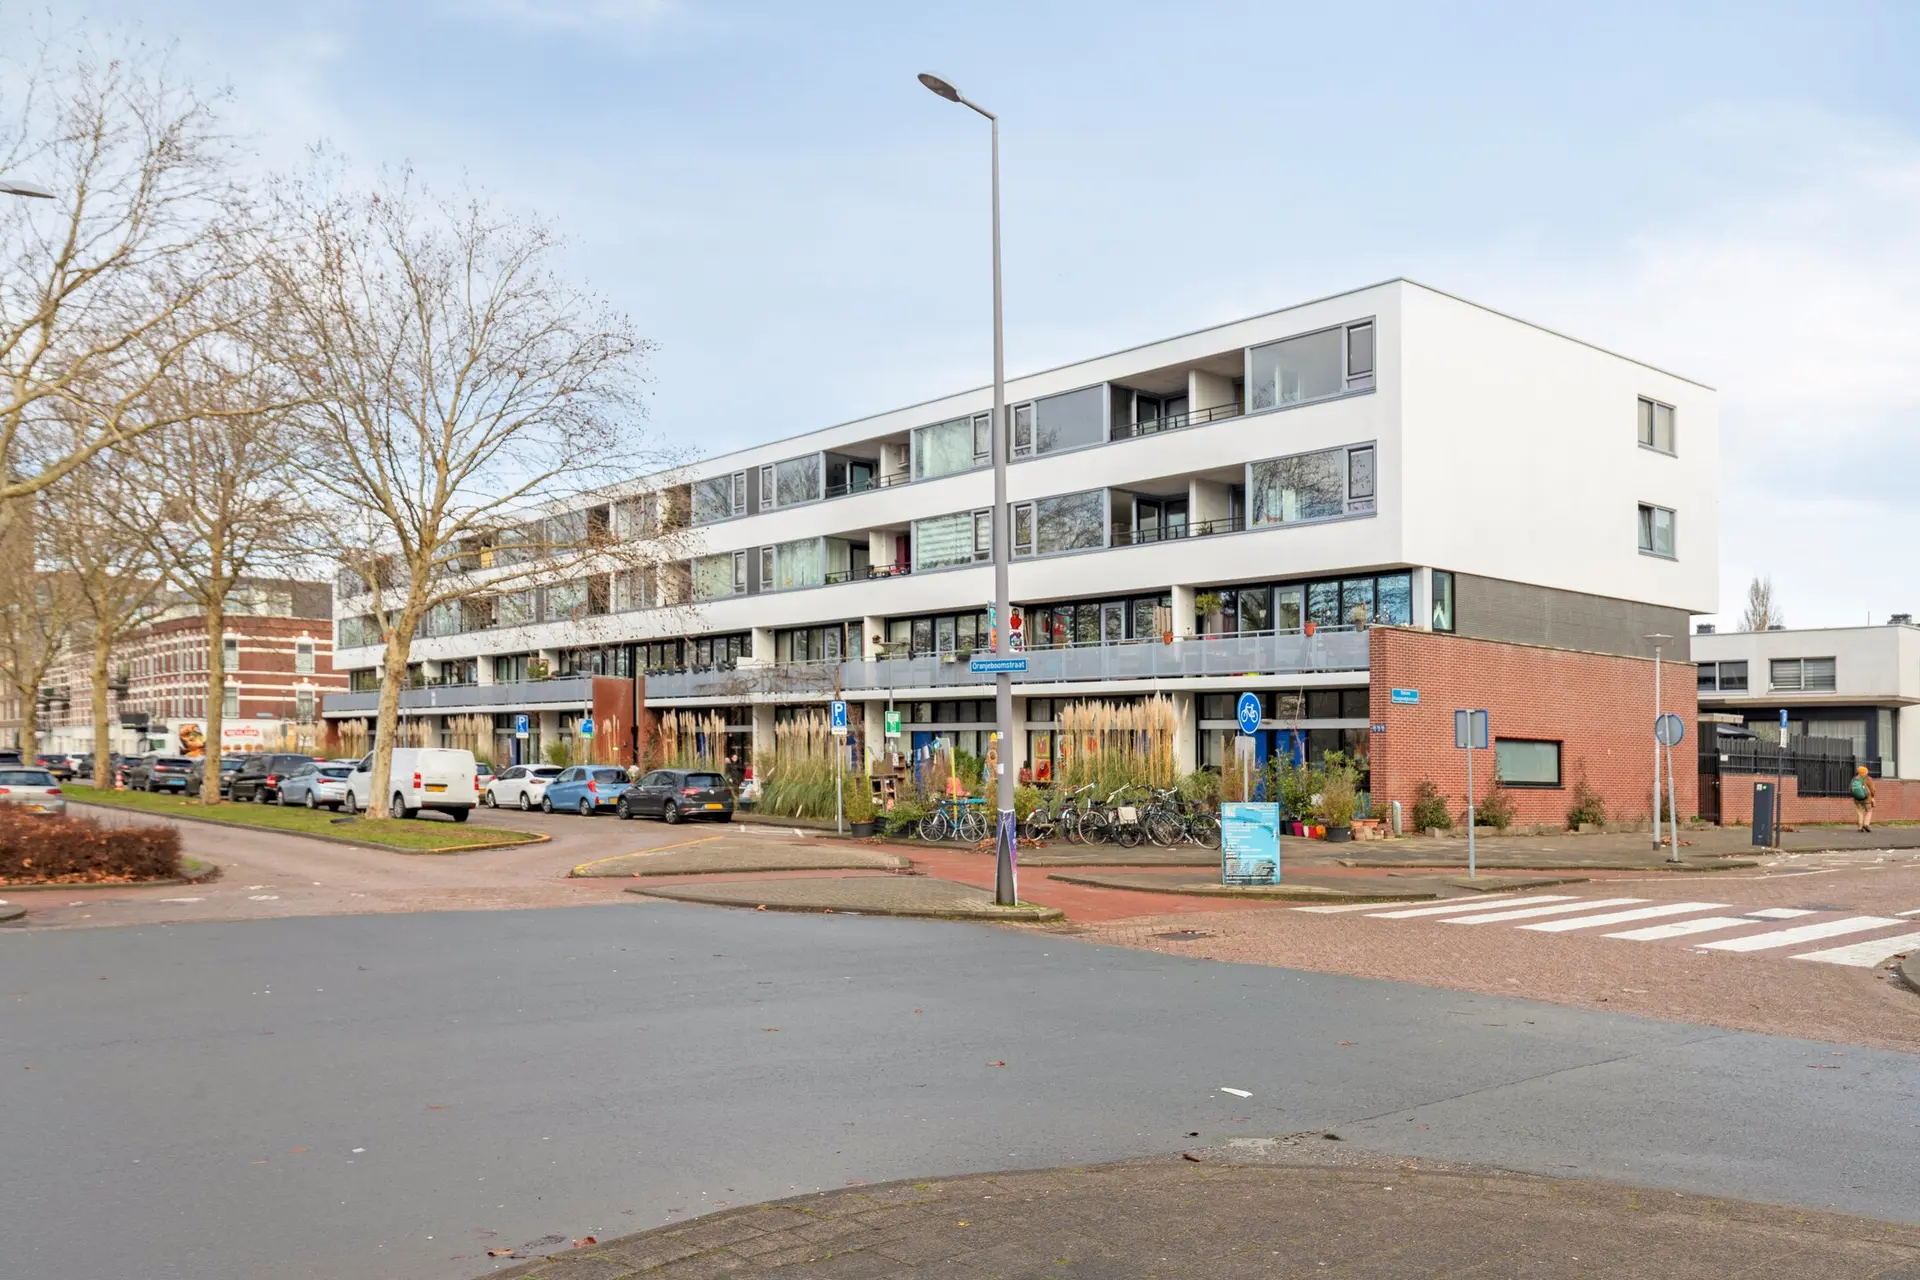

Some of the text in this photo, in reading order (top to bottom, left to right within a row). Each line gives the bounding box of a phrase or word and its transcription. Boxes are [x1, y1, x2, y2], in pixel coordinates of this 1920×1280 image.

[972, 661, 1025, 672] Oranjeboomstraat
[834, 703, 843, 717] P
[519, 716, 525, 725] P
